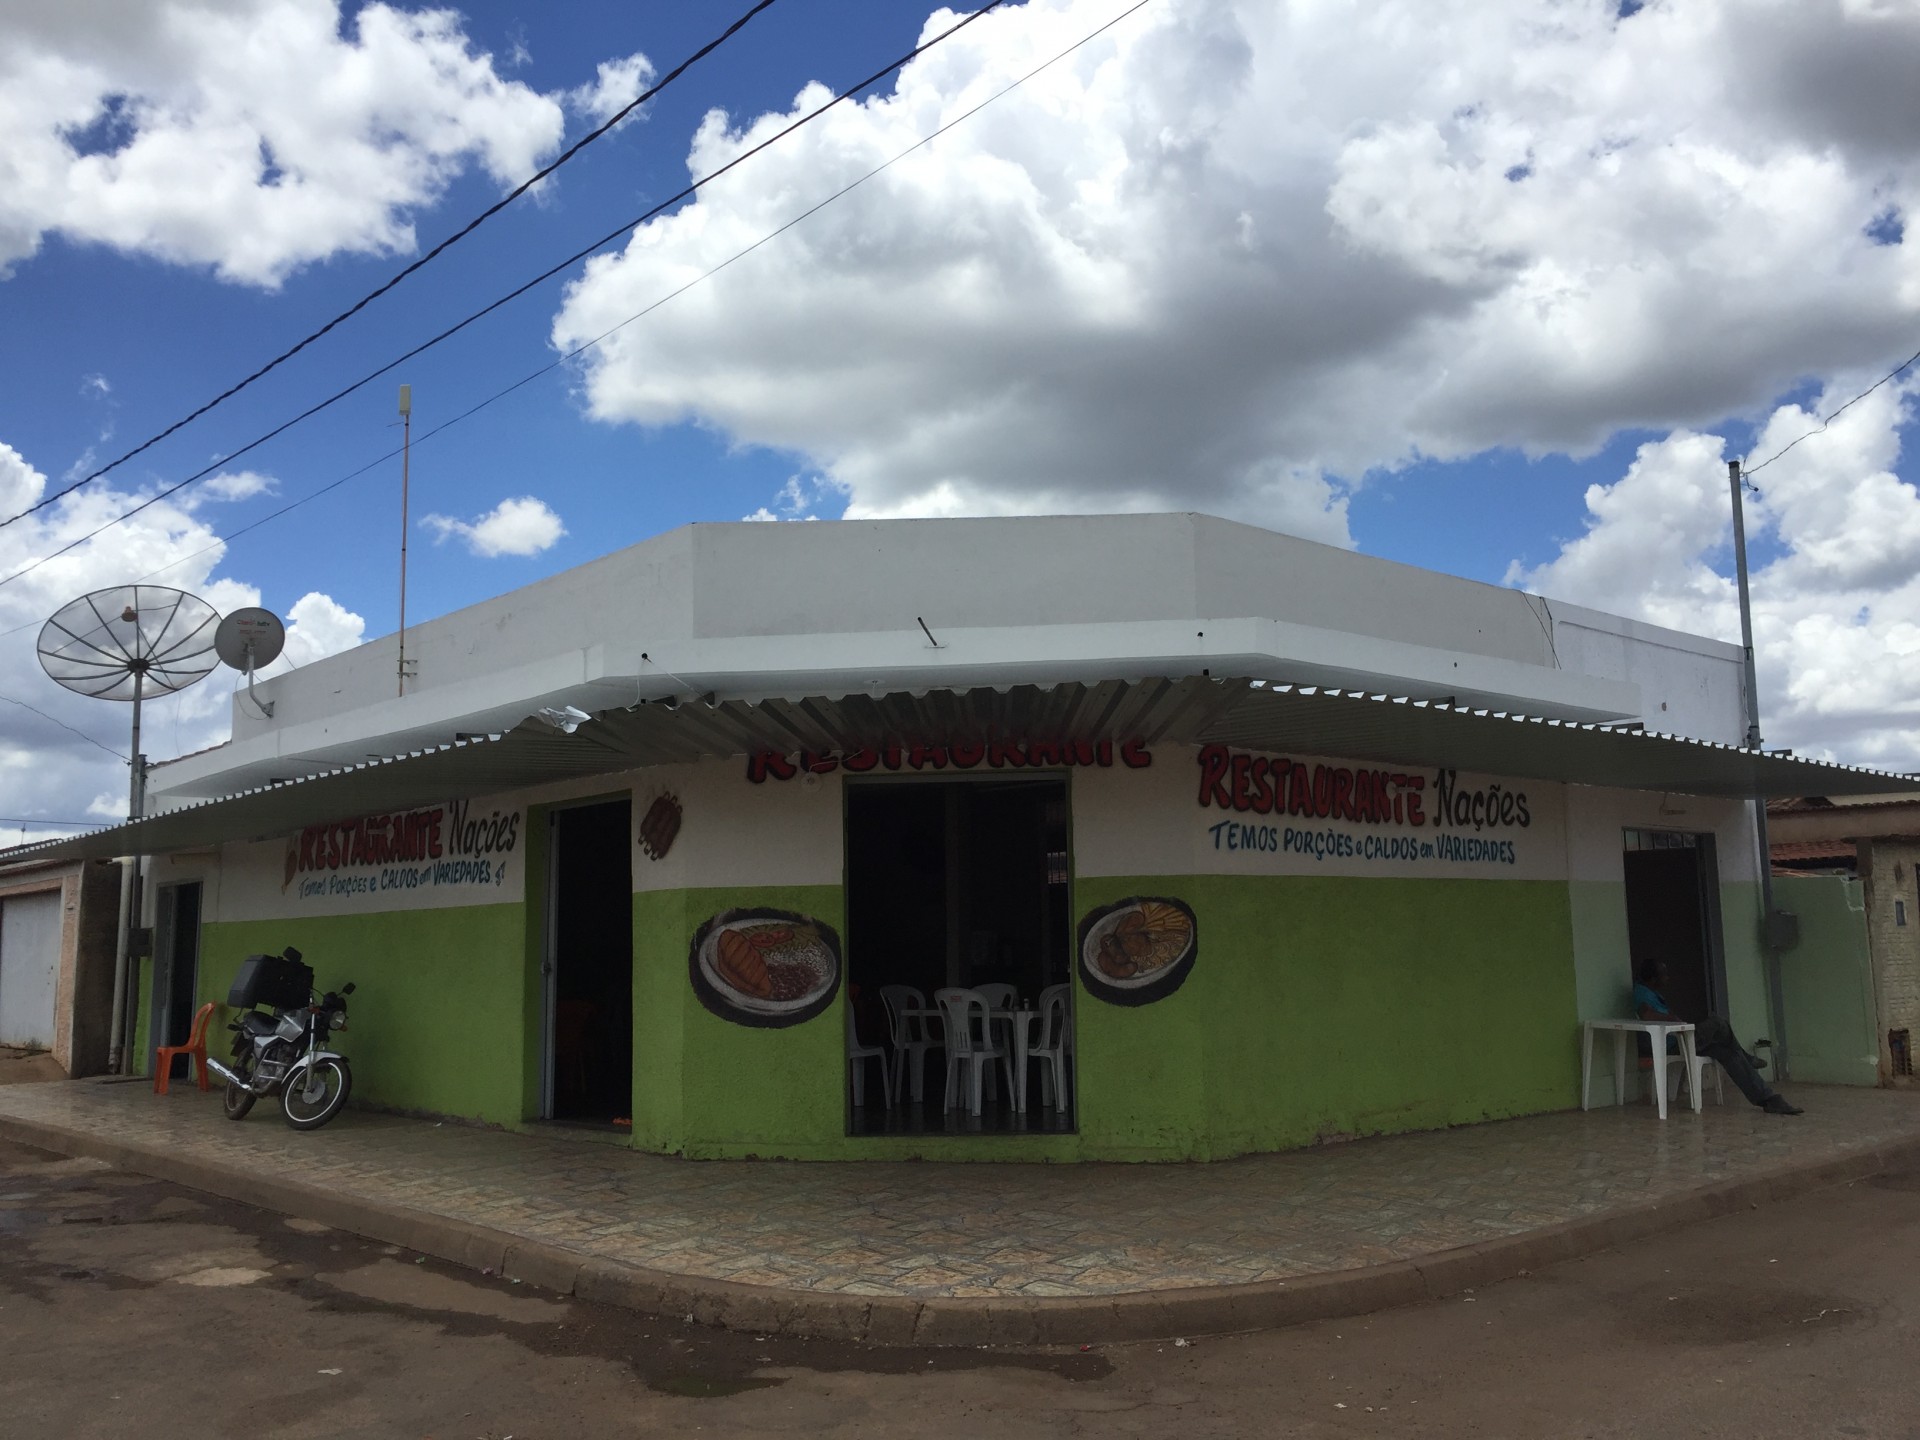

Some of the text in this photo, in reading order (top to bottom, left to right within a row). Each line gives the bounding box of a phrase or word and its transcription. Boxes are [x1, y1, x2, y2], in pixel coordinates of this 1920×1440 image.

[1198, 744, 1531, 832] RESTAURANTE Nações
[298, 799, 521, 872] RESTAURANTE Nações
[1209, 819, 1278, 852] TEMOS
[1355, 840, 1363, 855] e
[1364, 834, 1418, 861] CALDOS
[1420, 842, 1436, 859] em
[1436, 832, 1516, 865] VARIEDADES
[369, 876, 377, 892] e
[380, 868, 418, 891] CALDOS
[433, 859, 491, 887] VARIEDADES
